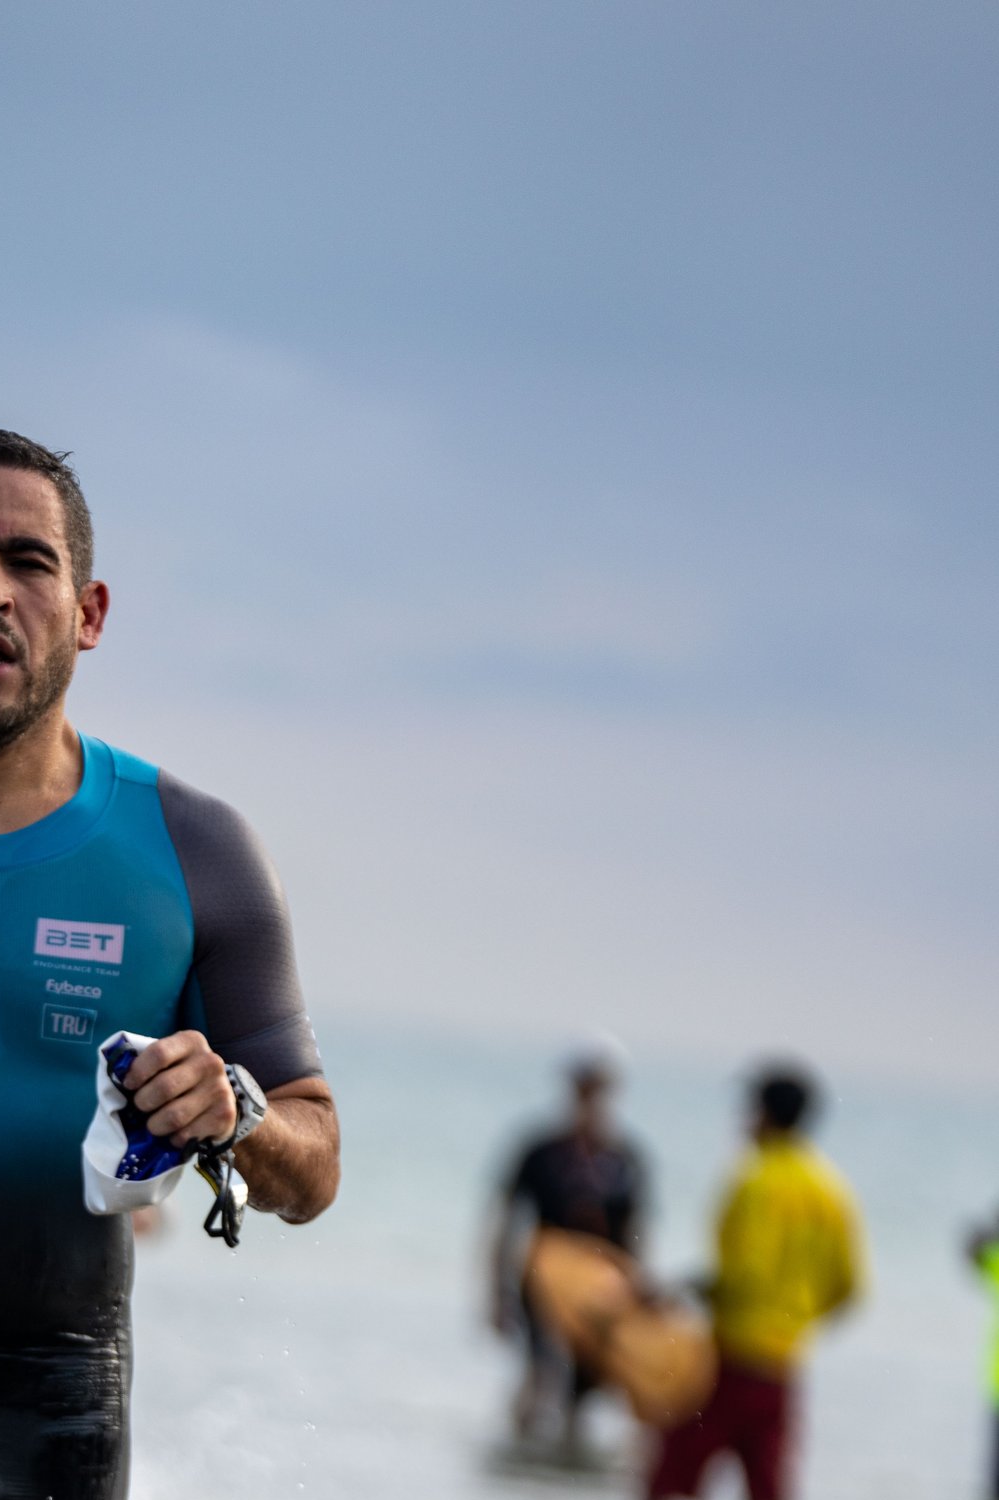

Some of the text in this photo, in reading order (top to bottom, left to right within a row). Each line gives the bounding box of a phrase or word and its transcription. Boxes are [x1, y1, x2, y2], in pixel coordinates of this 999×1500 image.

[45, 929, 114, 951] BET
[33, 960, 120, 977] ENDURANCE TEAM
[51, 1012, 88, 1036] TRU
